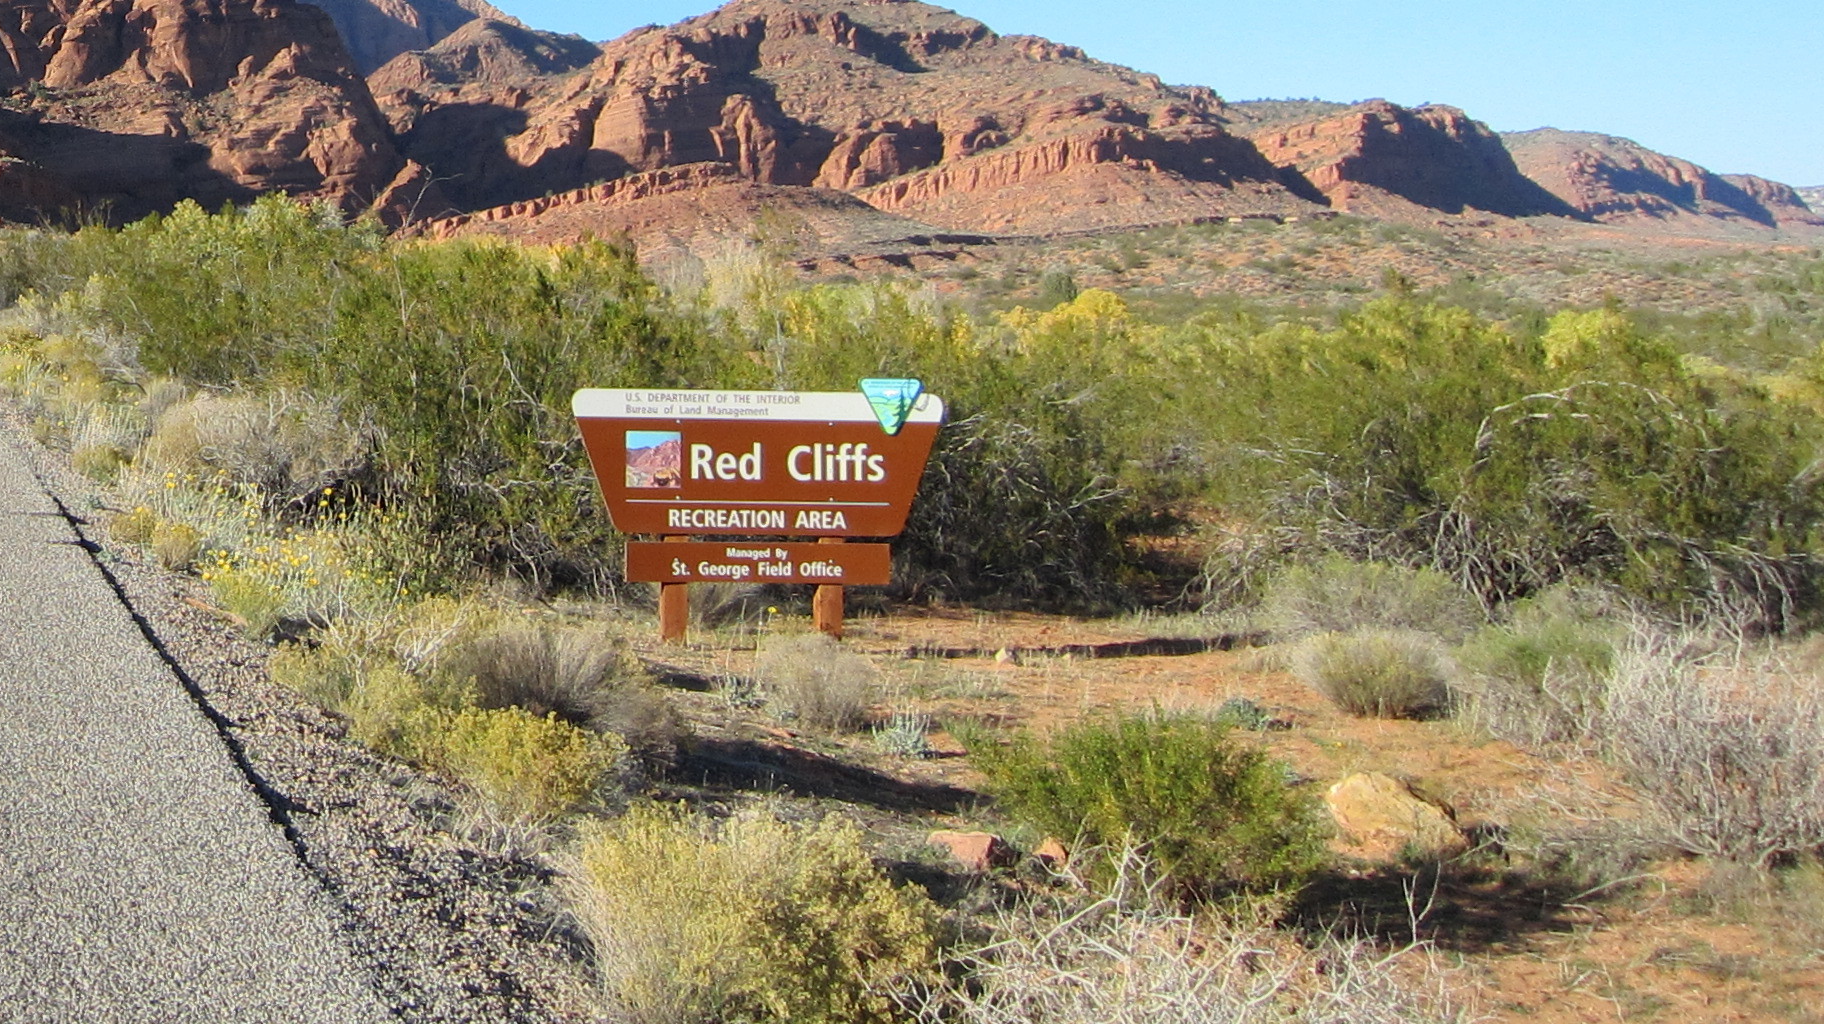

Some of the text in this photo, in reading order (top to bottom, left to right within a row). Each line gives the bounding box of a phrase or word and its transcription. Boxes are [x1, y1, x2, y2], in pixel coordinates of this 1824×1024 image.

[626, 393, 800, 404] U.S. DEPARTMENT OF THE INTERIOR
[626, 405, 769, 417] Bureau of Land Management
[691, 442, 885, 482] Red Cliffs
[669, 509, 847, 529] RECREATION AREA
[726, 548, 788, 560] Managed By
[672, 562, 842, 579] St. George Field Office
